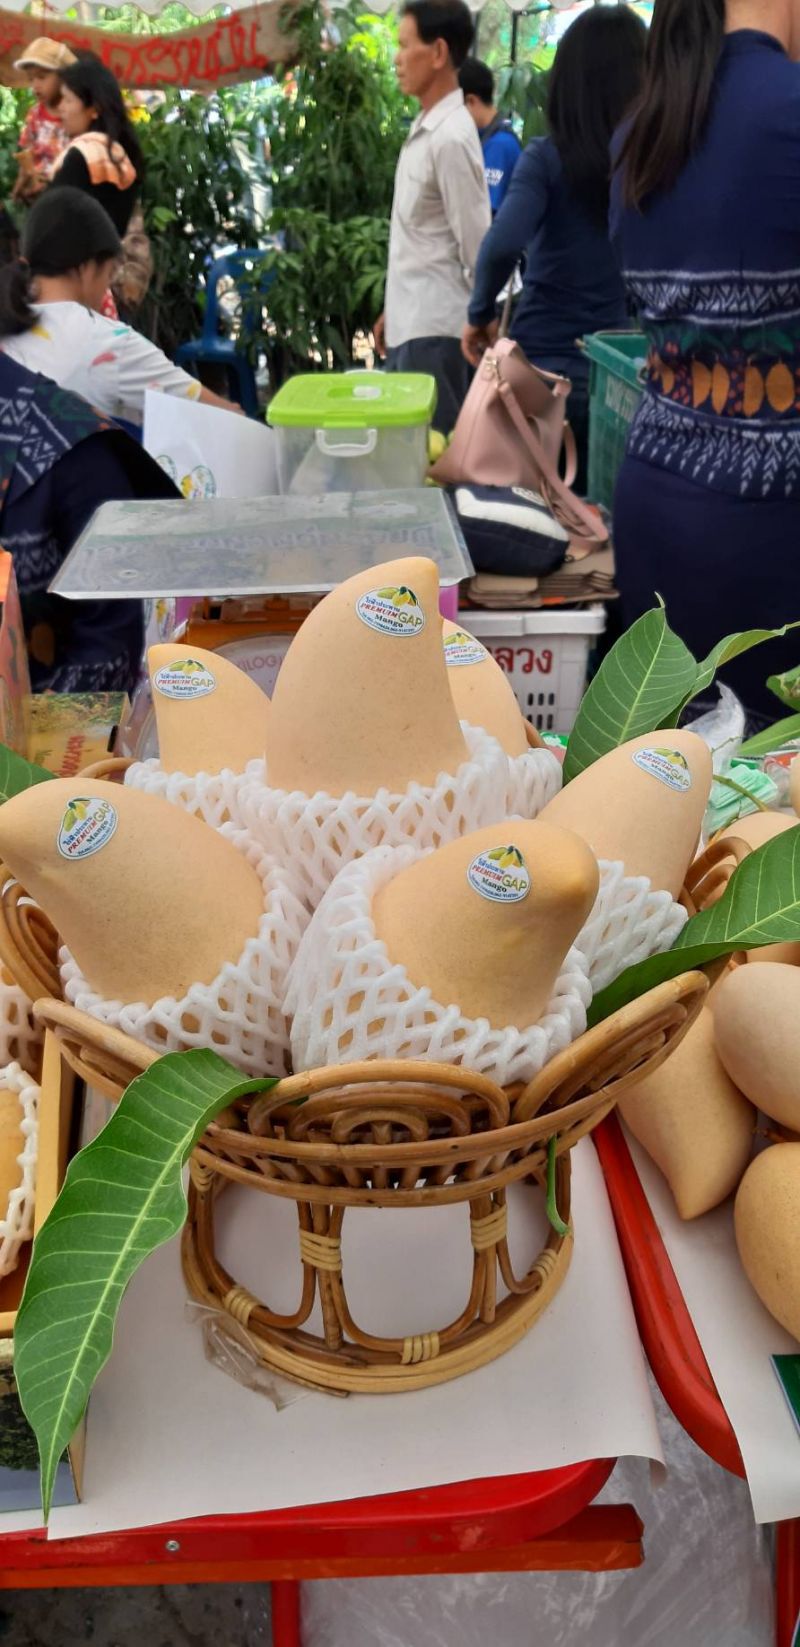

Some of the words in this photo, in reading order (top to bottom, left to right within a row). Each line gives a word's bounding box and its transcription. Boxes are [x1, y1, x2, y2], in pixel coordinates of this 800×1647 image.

[360, 602, 398, 618] PREMUIM
[398, 611, 423, 628] GAP
[374, 613, 404, 628] Mango
[487, 646, 553, 675] ลวง
[191, 677, 214, 688] GAP
[67, 820, 98, 854] PREMUIM
[93, 802, 111, 822] GAP
[86, 820, 109, 844] Mango
[482, 877, 507, 893] Mango
[501, 874, 528, 892] GAP
